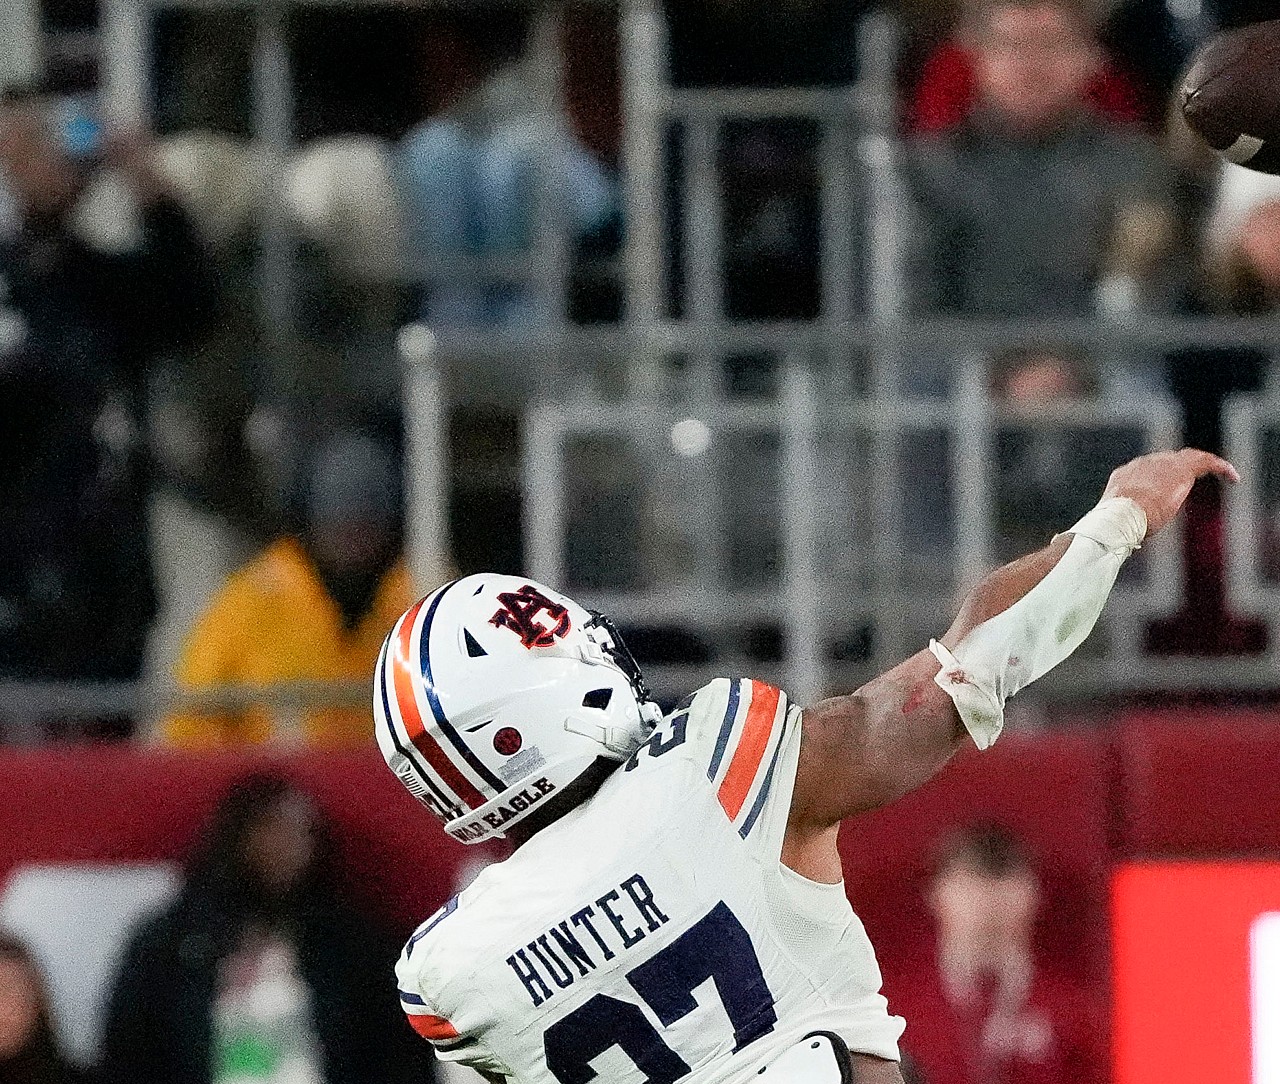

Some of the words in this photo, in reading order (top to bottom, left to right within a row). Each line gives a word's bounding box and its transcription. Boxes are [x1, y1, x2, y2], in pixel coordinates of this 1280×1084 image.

[451, 821, 489, 842] WAR
[482, 777, 556, 830] EAGLE
[506, 873, 669, 1007] HUNTER
